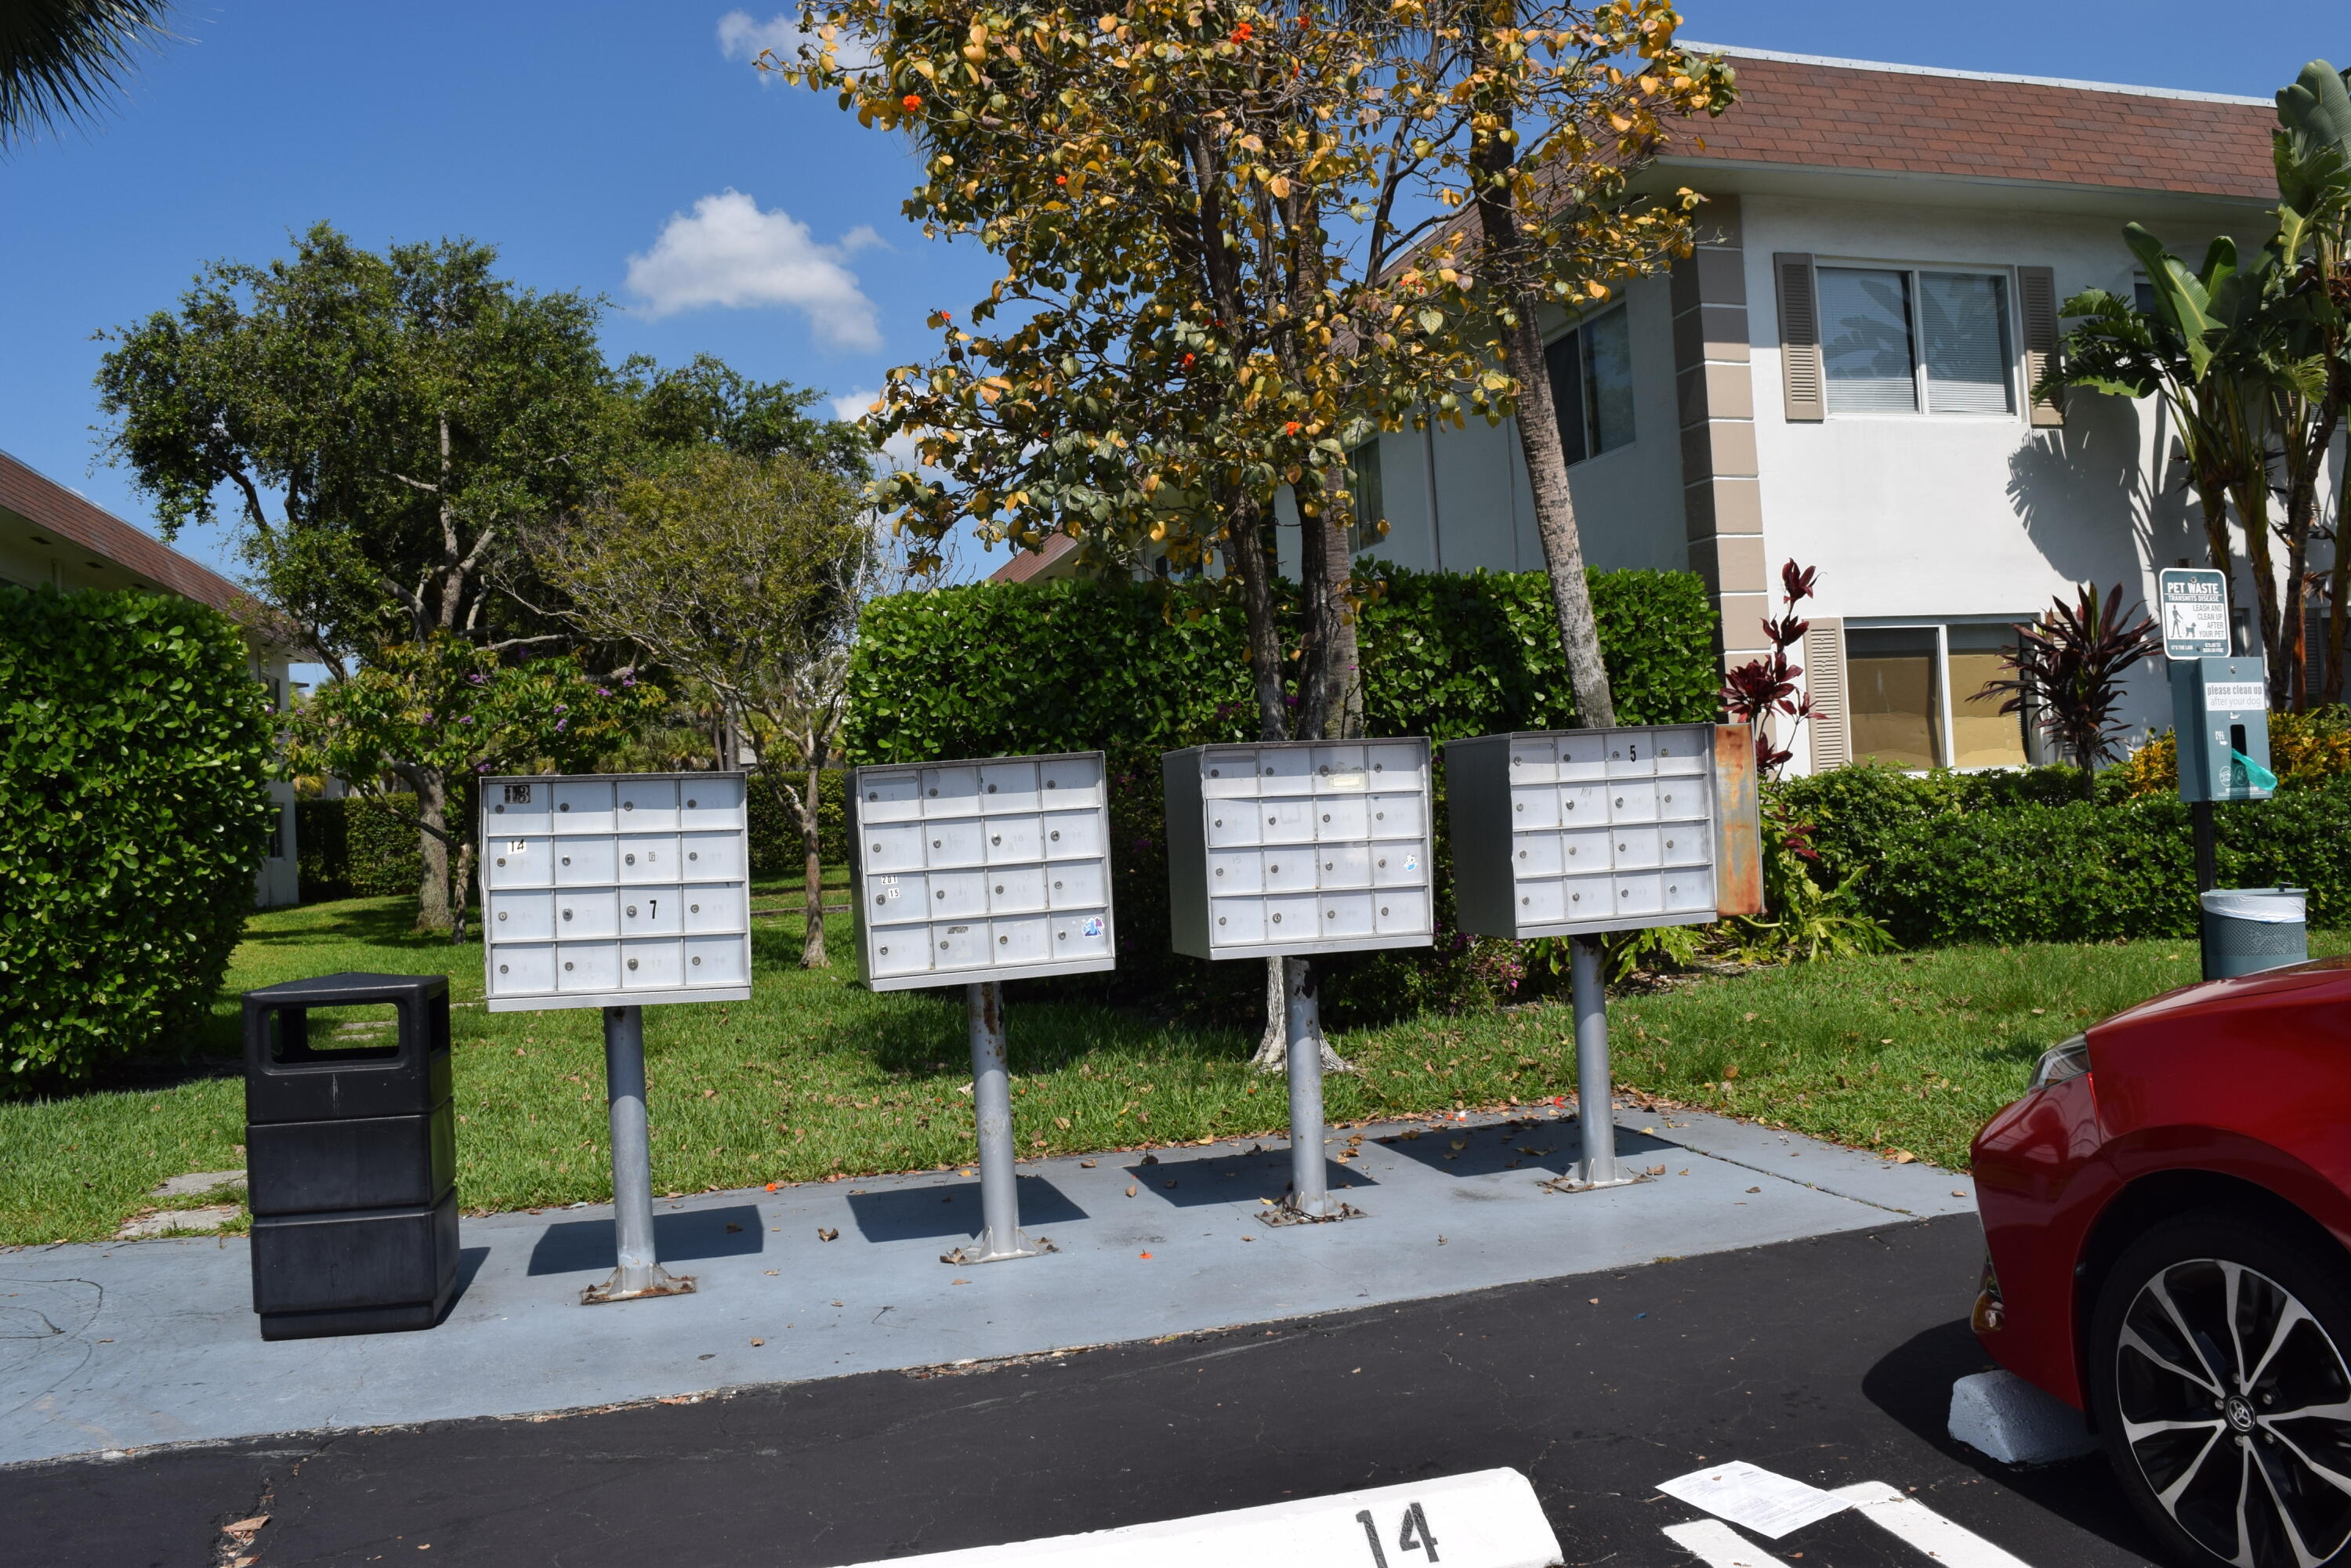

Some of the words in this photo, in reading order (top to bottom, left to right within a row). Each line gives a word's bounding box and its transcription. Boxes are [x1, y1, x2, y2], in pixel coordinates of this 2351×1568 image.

[2167, 582, 2185, 593] PET
[2187, 582, 2219, 594] WASTE
[2207, 686, 2231, 696] please
[2233, 686, 2252, 695] clean
[2253, 686, 2262, 696] up
[2210, 697, 2227, 706] after
[2229, 698, 2245, 708] your
[2248, 697, 2261, 708] dog
[1630, 744, 1636, 762] 5
[506, 785, 531, 803] 13
[511, 838, 524, 853] 14
[882, 875, 897, 884] 201
[649, 900, 657, 920] 7
[1356, 1501, 1440, 1568] 14
